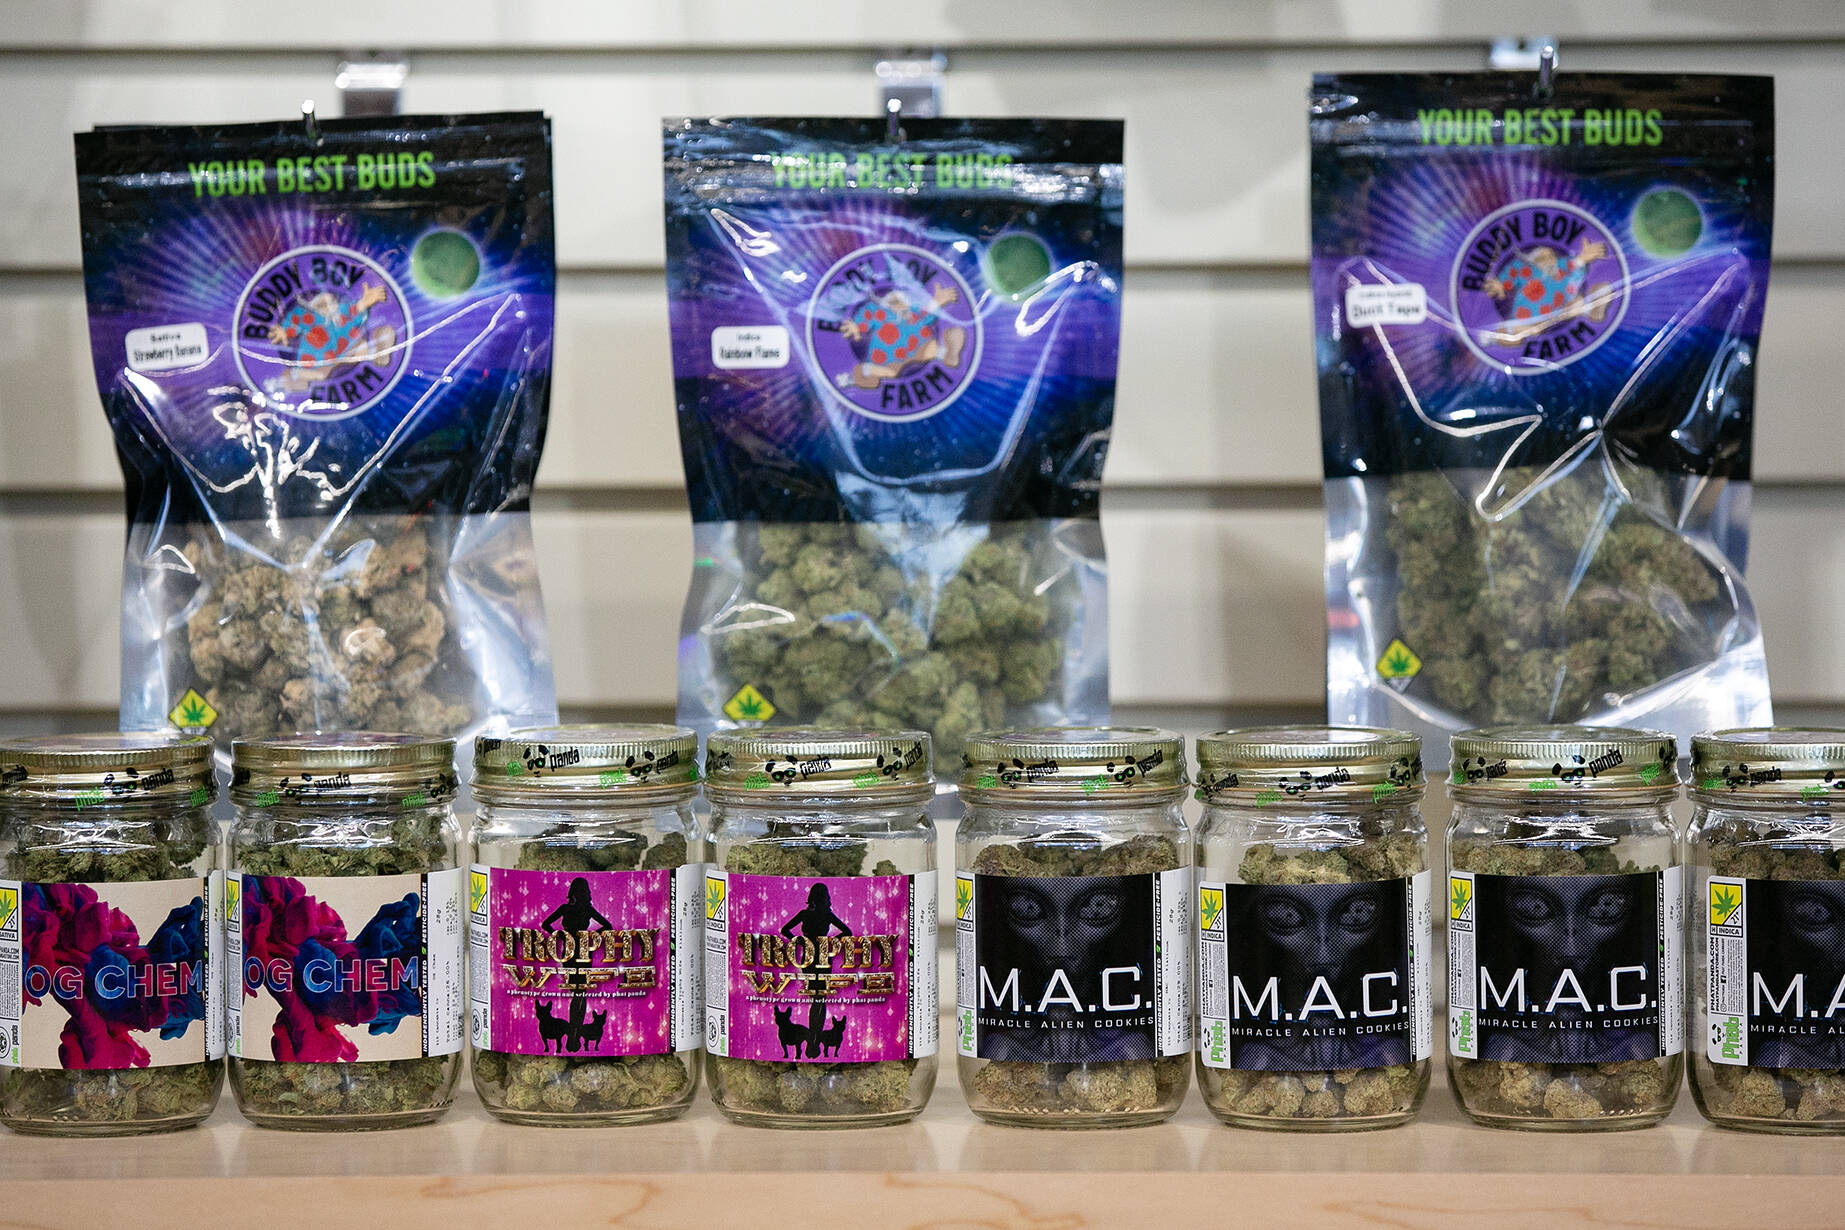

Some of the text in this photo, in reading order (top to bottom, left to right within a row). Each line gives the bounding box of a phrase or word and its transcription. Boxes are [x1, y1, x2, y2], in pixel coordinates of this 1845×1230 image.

[1417, 108, 1664, 146] YOUR BEST BUDS
[188, 150, 437, 198] YOUR BEST BUDS
[771, 151, 1014, 190] YOUR BEST BUDS
[1533, 212, 1586, 245] BOY
[244, 257, 365, 340] BUDDY BOY
[1522, 321, 1596, 360] FARM
[311, 365, 384, 405] FARM
[882, 365, 954, 409] FARM
[141, 767, 174, 790] panda
[1589, 749, 1624, 777] panda
[499, 926, 661, 963] TROPHY
[1206, 932, 1222, 940] INDICA
[1718, 927, 1740, 935] INDICA
[737, 932, 900, 969] TROPHY
[25, 964, 84, 999] OG
[95, 959, 202, 999] CHEM
[245, 956, 293, 993] OG
[303, 956, 418, 993] CHEM
[502, 964, 655, 990] WIFE
[741, 969, 895, 996] WIFE
[979, 965, 1152, 1013] M.A.C.
[1480, 965, 1657, 1013] M.A.C.
[1232, 971, 1407, 1021] M.A.C.
[978, 1017, 1154, 1029] MIRACLE ALIEN COOKIES
[1232, 1021, 1409, 1037] MIRACLE ALIEN COOKIES
[1479, 1017, 1658, 1029] MIRACLE ALIEN COOKIES
[1750, 1024, 1817, 1034] MIRACLE
